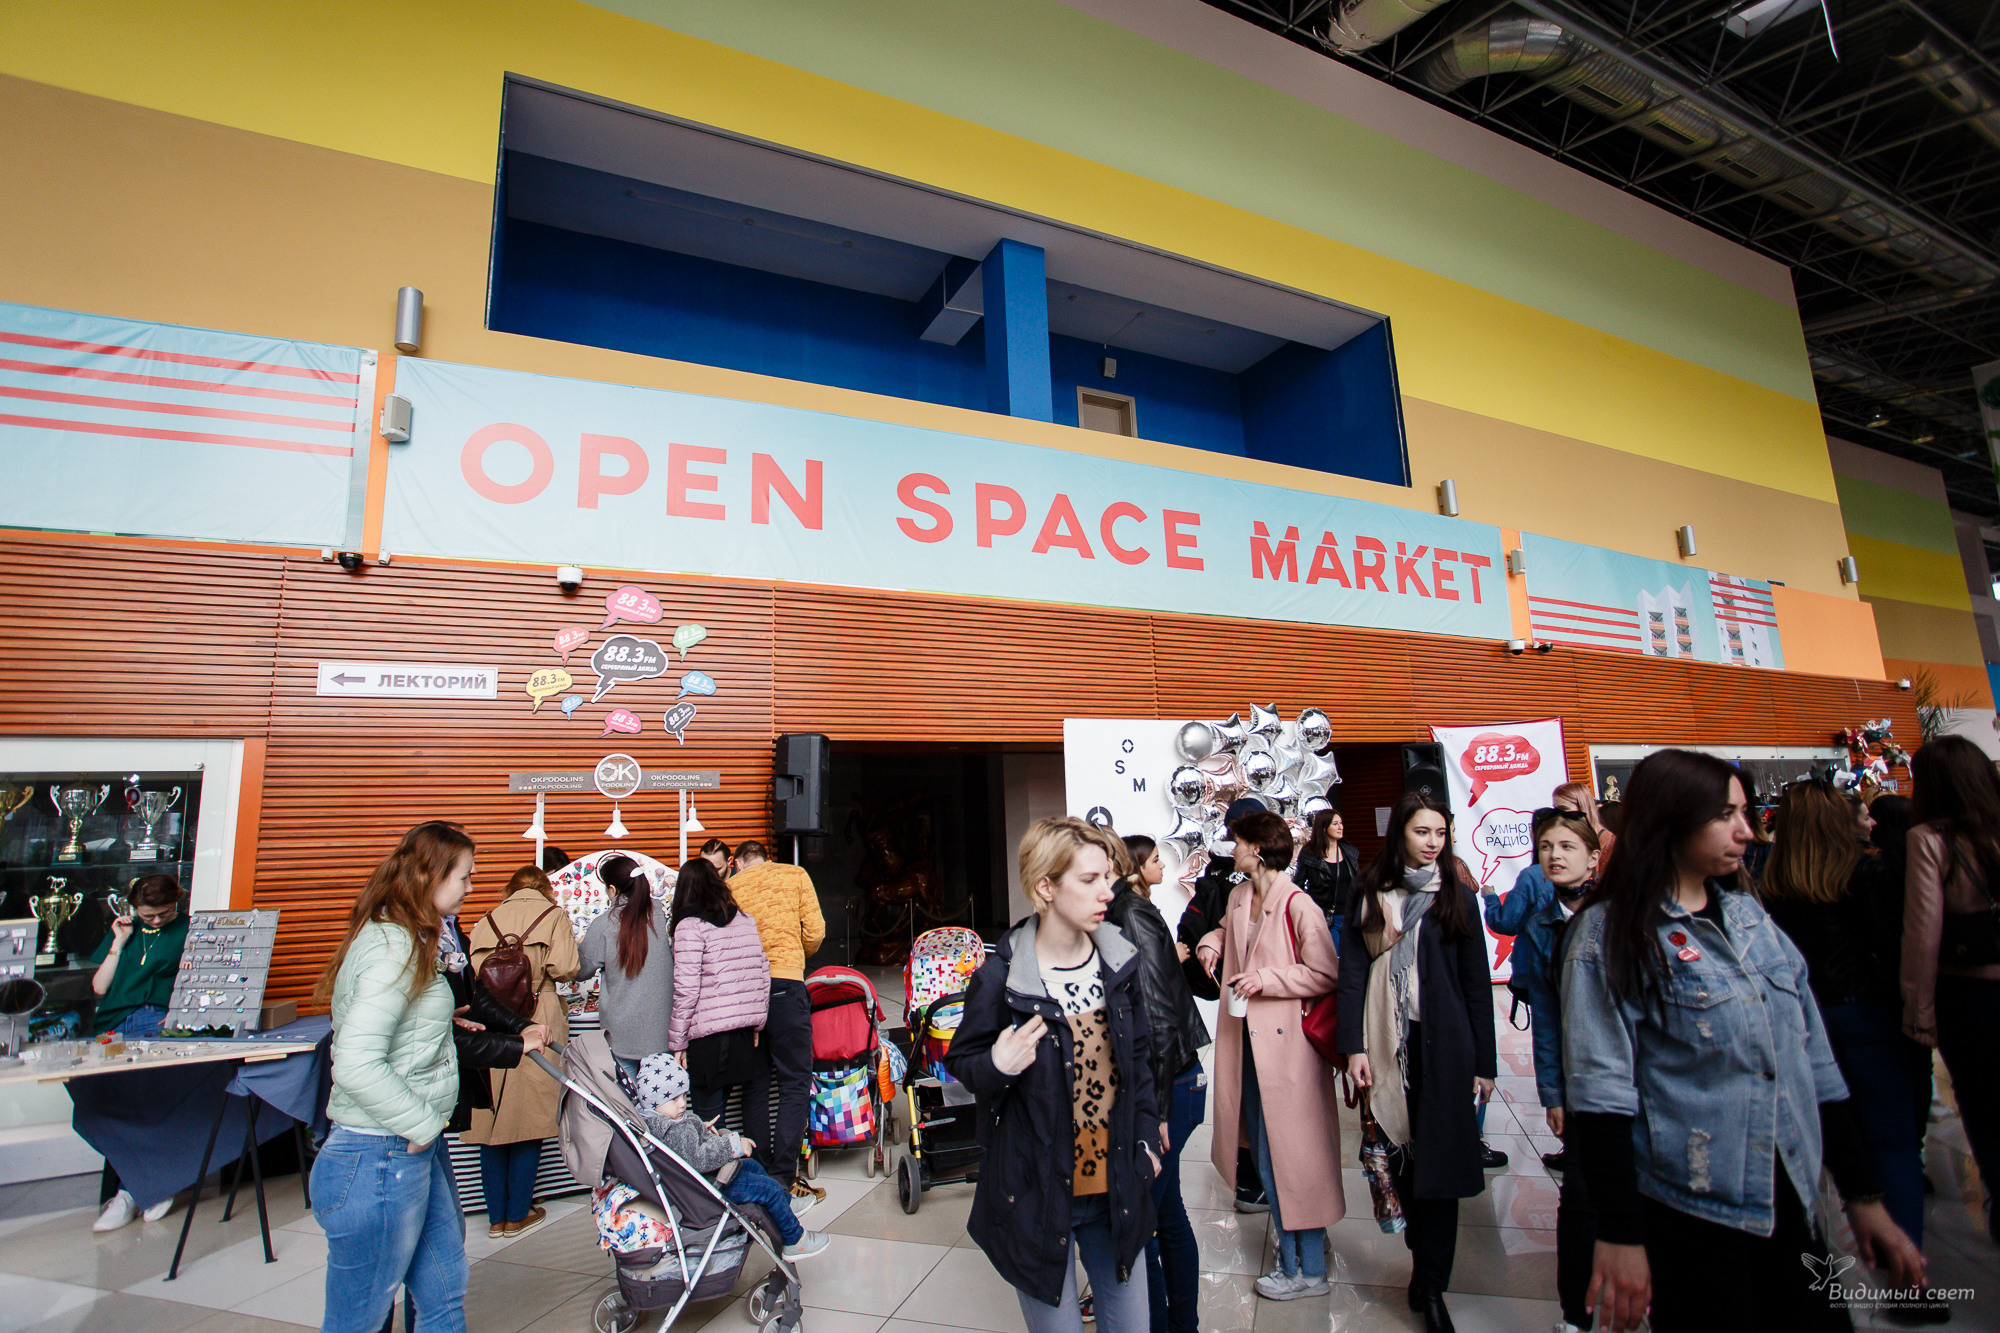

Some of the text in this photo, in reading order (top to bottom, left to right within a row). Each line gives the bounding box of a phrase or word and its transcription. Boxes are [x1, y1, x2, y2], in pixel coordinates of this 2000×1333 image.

[460, 422, 1491, 603] OPEN SPACE MARKET
[378, 673, 487, 689] ЛЕКТОРИЙ
[599, 762, 635, 782] OK
[1474, 763, 1508, 771] СЕРЕБРЯНЫЙ
[1486, 835, 1529, 848] РАДИО
